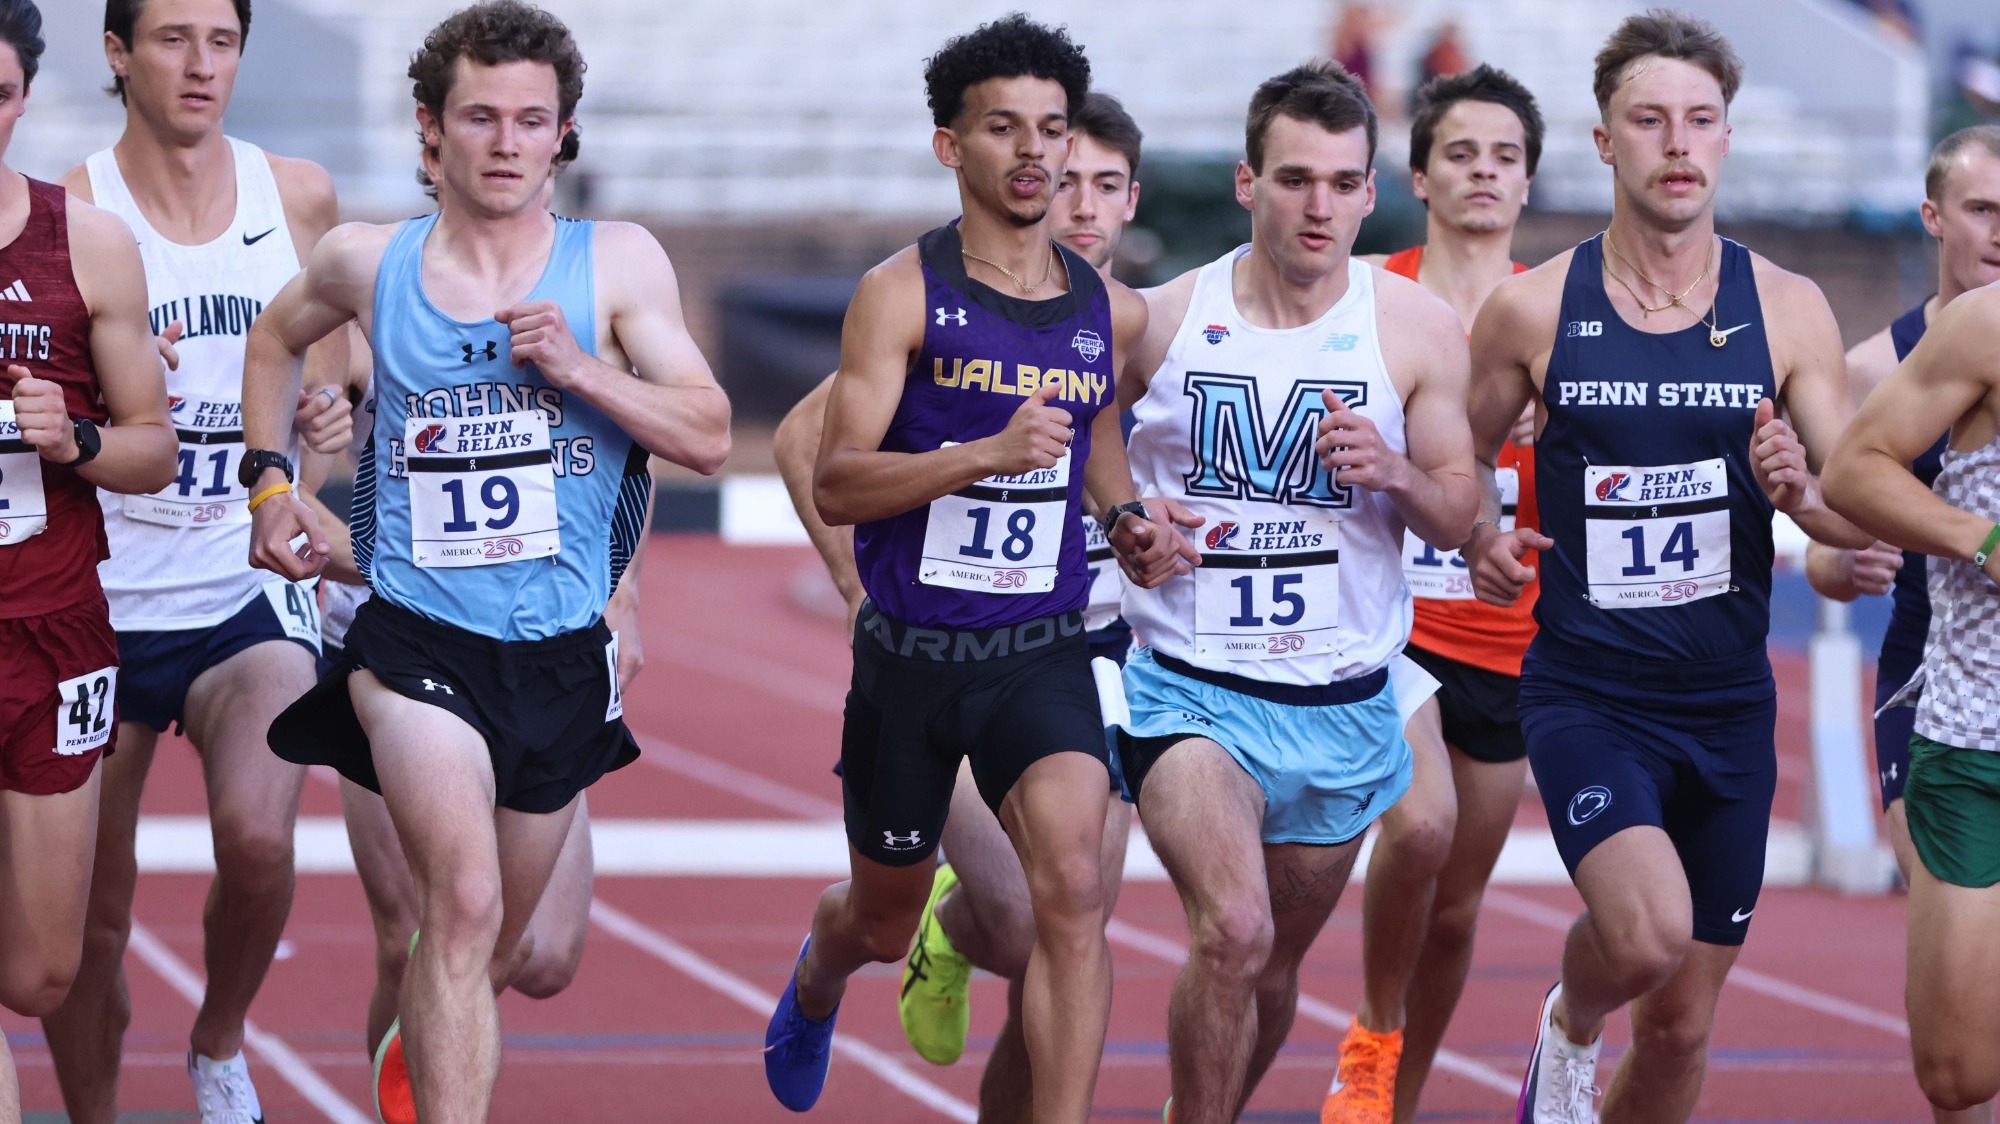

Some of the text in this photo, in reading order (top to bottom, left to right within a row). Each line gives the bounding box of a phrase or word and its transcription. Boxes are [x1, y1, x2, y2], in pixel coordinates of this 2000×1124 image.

[149, 294, 262, 341] VILLANOV
[1073, 337, 1104, 348] AMERICA
[1081, 346, 1099, 354] EAST
[934, 358, 1107, 405] UALBANY
[1559, 381, 1763, 408] PENN STATE
[406, 382, 563, 428] JOHNS
[192, 414, 243, 428] RELA
[457, 419, 514, 438] PENN
[456, 432, 533, 453] RELAYS
[1183, 371, 1368, 508] M
[174, 449, 231, 496] 41
[1642, 469, 1695, 486] PENN
[1639, 481, 1712, 500] RELAYS
[151, 503, 227, 522] AMERICA 250
[441, 475, 520, 533] 19
[959, 506, 1036, 562] 18
[1251, 521, 1306, 535] PENN
[440, 538, 524, 558] AMERICA 250
[1248, 533, 1323, 550] RELAYS
[1621, 521, 1700, 577] 14
[949, 569, 1028, 588] AMERICA 250
[1230, 573, 1306, 627] 15
[1617, 581, 1699, 601] AMERICA 250
[1224, 634, 1305, 654] AMERICA 250
[69, 675, 109, 735] 42
[66, 736, 88, 747] PENN
